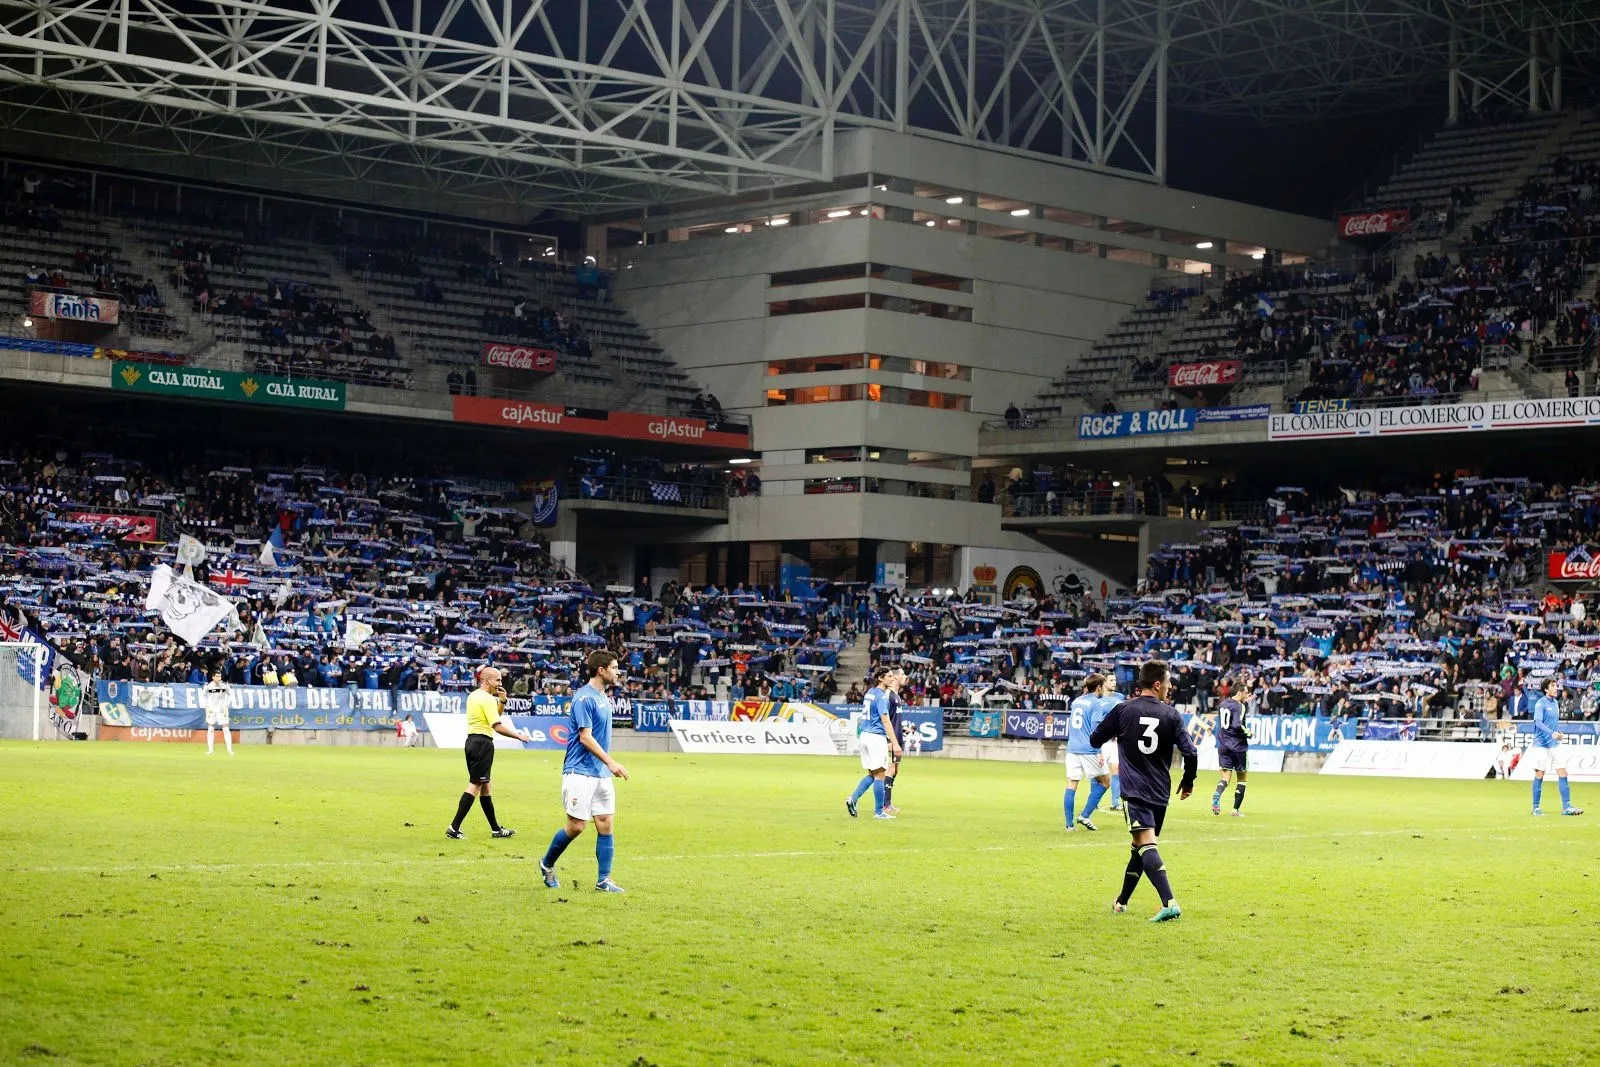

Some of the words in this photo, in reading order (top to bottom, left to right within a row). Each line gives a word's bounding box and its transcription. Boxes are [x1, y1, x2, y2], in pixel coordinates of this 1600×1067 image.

[54, 295, 99, 319] Fanta
[488, 346, 534, 369] Coca-Cola
[149, 371, 179, 386] CAJA
[182, 374, 224, 390] RURAL
[1175, 364, 1220, 386] Coca-Cola
[266, 382, 296, 398] CAJA
[298, 385, 339, 401] RURAL
[502, 404, 563, 424] cajAstur
[1298, 398, 1349, 413] TENSI
[1379, 410, 1397, 426] EL
[1400, 404, 1485, 425] COMERCIO
[1491, 405, 1511, 420] EL
[1513, 399, 1600, 418] COMERCIO
[648, 419, 705, 438] cajAstur
[1130, 414, 1141, 433] &
[1147, 409, 1188, 431] ROLL
[1271, 416, 1289, 431] EL
[1291, 411, 1371, 430] COMERCIO
[230, 688, 297, 710] UTURO
[307, 688, 340, 710] DEL
[401, 690, 462, 713] OVIEDO
[536, 704, 562, 716] SM94
[336, 712, 354, 725] de
[677, 729, 756, 745] Tartiere
[765, 731, 811, 746] Auto
[1138, 717, 1159, 754] 3
